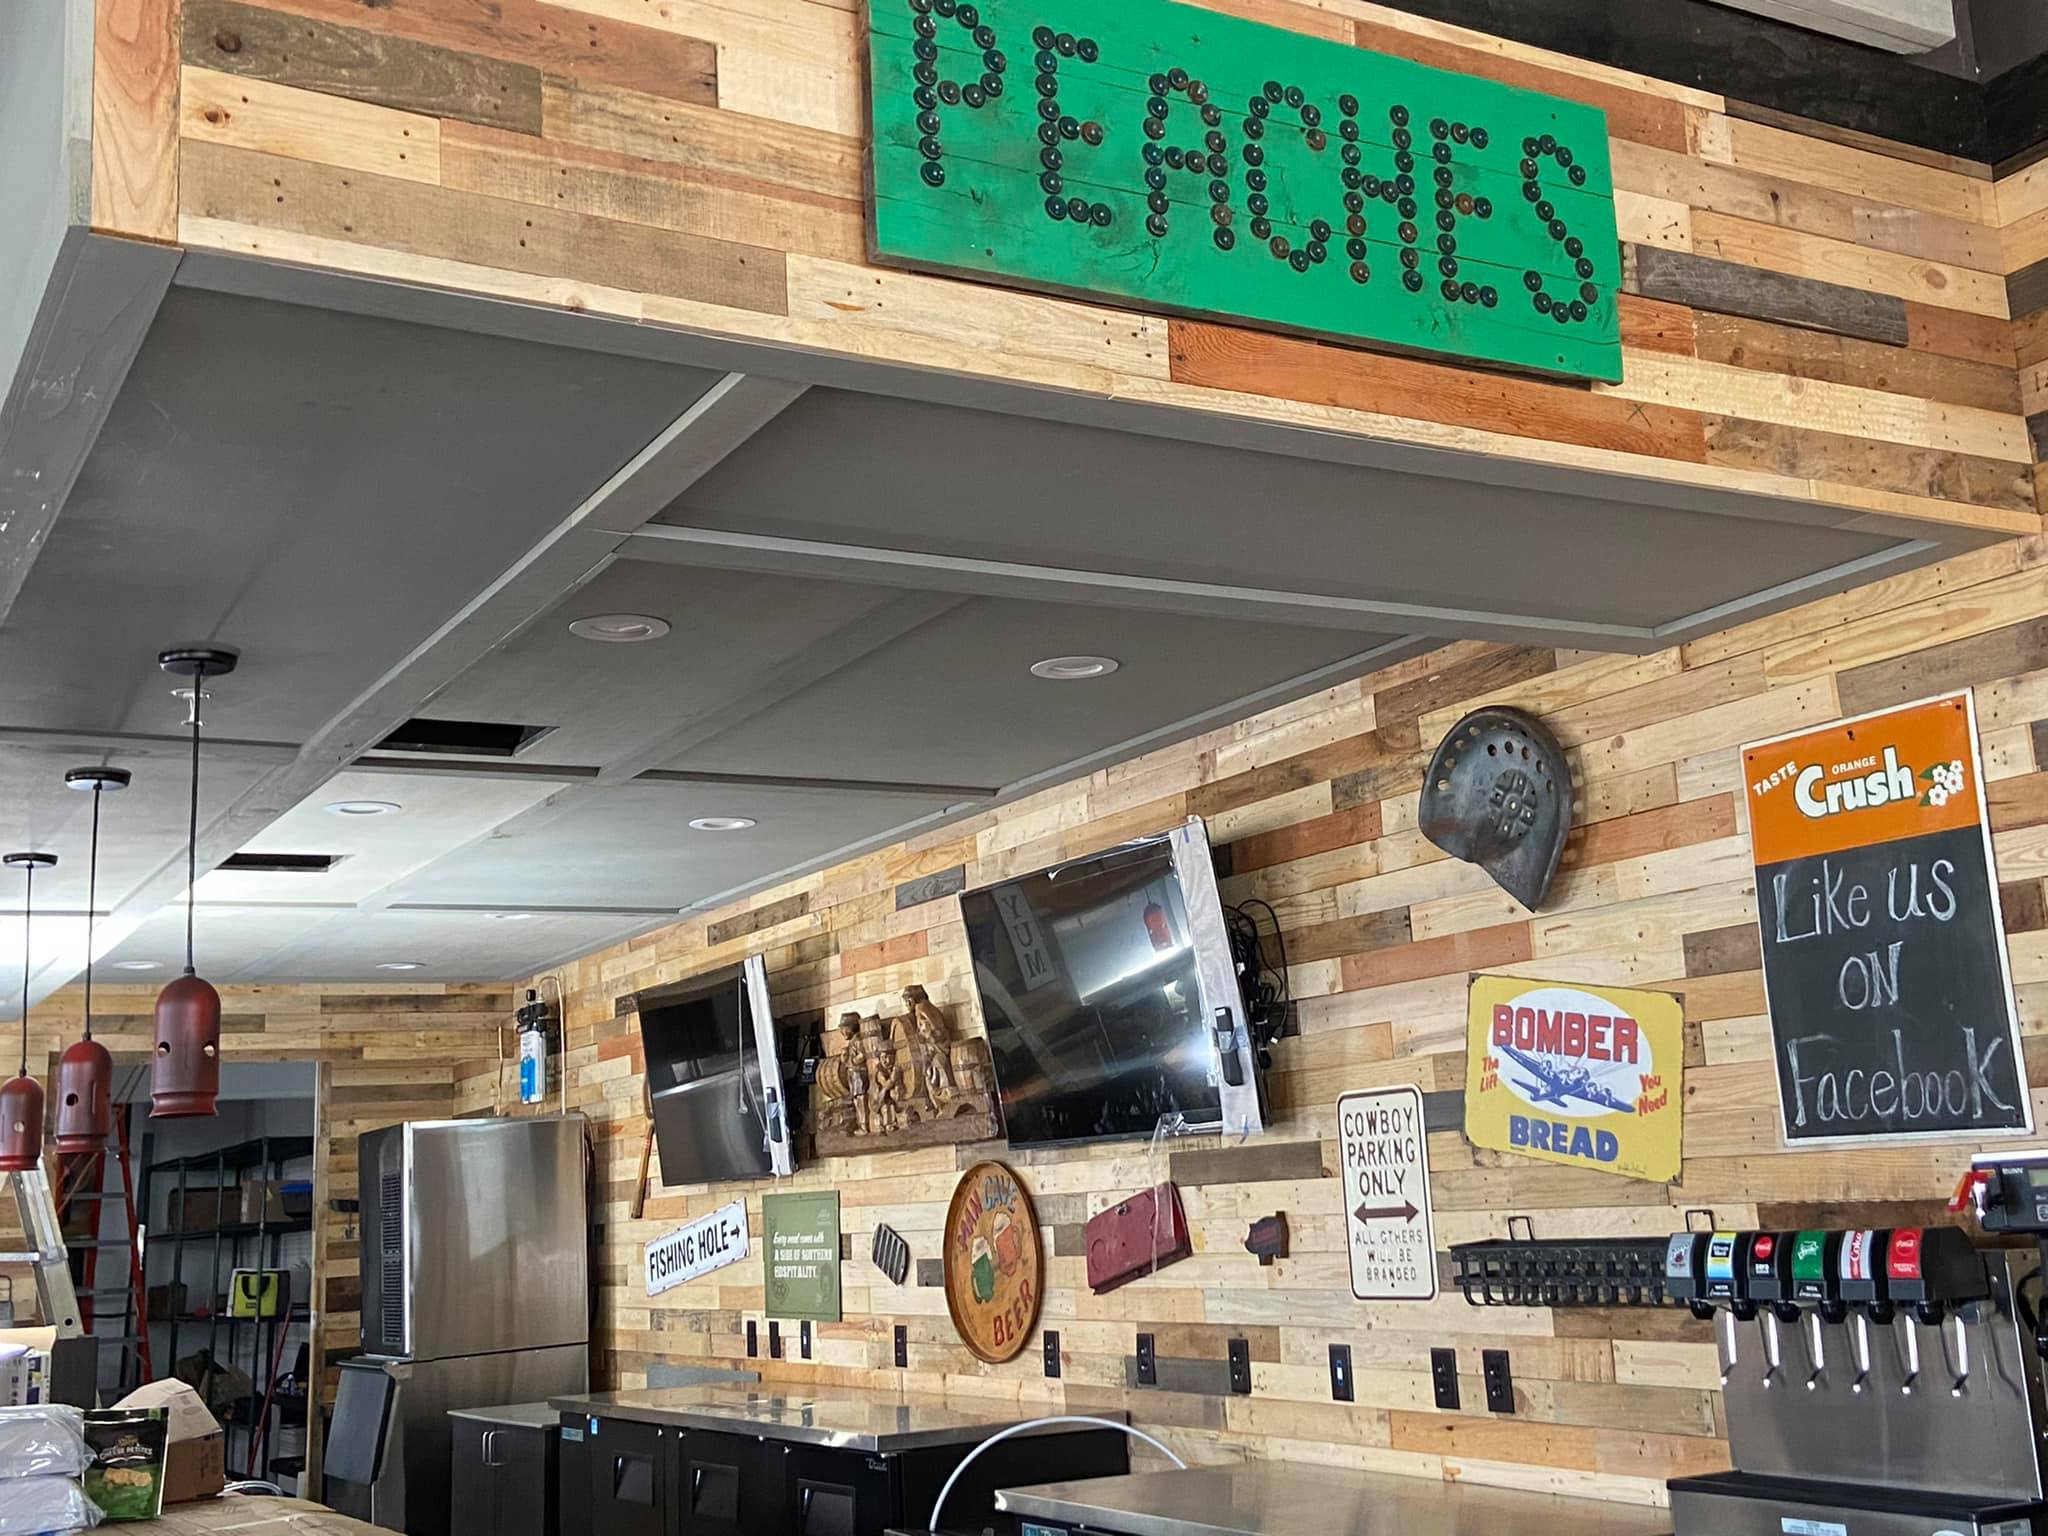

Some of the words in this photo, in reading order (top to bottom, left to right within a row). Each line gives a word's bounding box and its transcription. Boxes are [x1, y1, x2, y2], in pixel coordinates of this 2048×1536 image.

[912, 0, 1598, 323] PEACHES
[1752, 760, 1798, 797] TASTE
[1794, 745, 1915, 819] Crush
[1831, 755, 1877, 775] ORANGE
[1773, 860, 1871, 942] Like
[1492, 1004, 1638, 1064] BOMBER
[1639, 1073, 1662, 1092] You
[1344, 1106, 1413, 1138] COWBOY
[1509, 1115, 1619, 1162] BREAD
[1347, 1137, 1416, 1168] PARKING
[1359, 1168, 1406, 1196] ONLY
[649, 1235, 695, 1282] FISHING
[698, 1219, 729, 1261] HOLE
[1355, 1231, 1376, 1245] ALL
[1380, 1229, 1423, 1244] OTHERS
[1366, 1266, 1417, 1281] BRANDED
[1367, 1252, 1392, 1263] WILL
[1399, 1251, 1413, 1263] BE
[993, 1279, 1033, 1347] BEER
